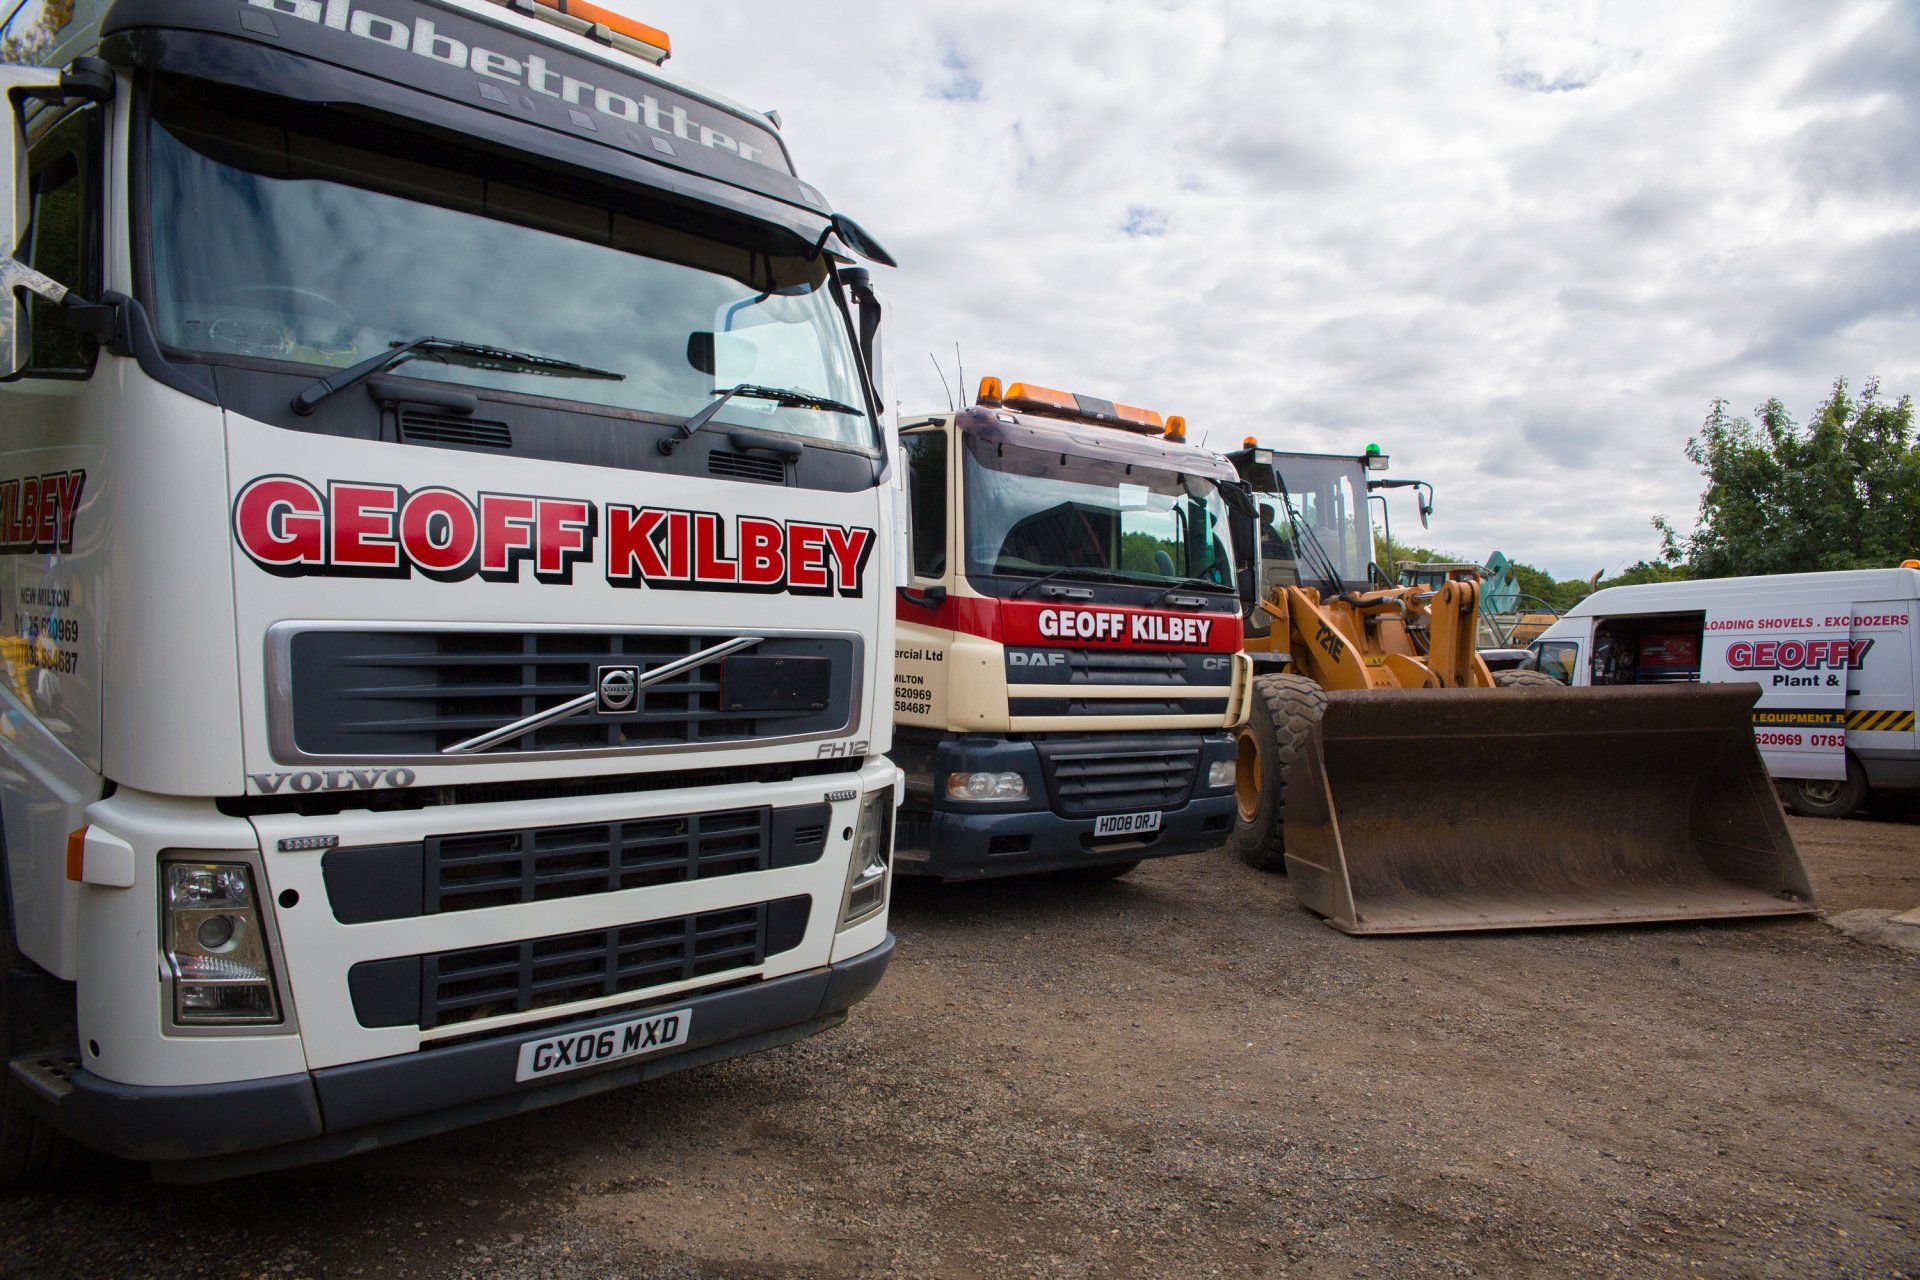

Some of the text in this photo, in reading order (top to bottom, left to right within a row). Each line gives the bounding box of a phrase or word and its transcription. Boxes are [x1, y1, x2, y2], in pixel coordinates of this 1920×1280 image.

[0, 469, 86, 554] ILBEY
[233, 474, 875, 598] GEOFF KILBEY
[20, 587, 70, 608] NEW MILTON
[1038, 608, 1213, 645] GEOFF KILBEY
[1704, 619, 1754, 631] LOADING
[1757, 617, 1813, 629] SHOVELS
[1853, 614, 1909, 627] DOZERS
[925, 649, 943, 662] Ltd
[1009, 652, 1230, 670] DAF CF
[1772, 674, 1840, 687] Plant &
[895, 687, 932, 701] 620969
[894, 700, 931, 715] 584687
[1760, 713, 1832, 723] EQUIPMENT
[247, 767, 416, 795] VOLVO
[1100, 813, 1158, 833] HD08 ORJ
[532, 1030, 616, 1073] GX06
[622, 1015, 679, 1053] MXD
